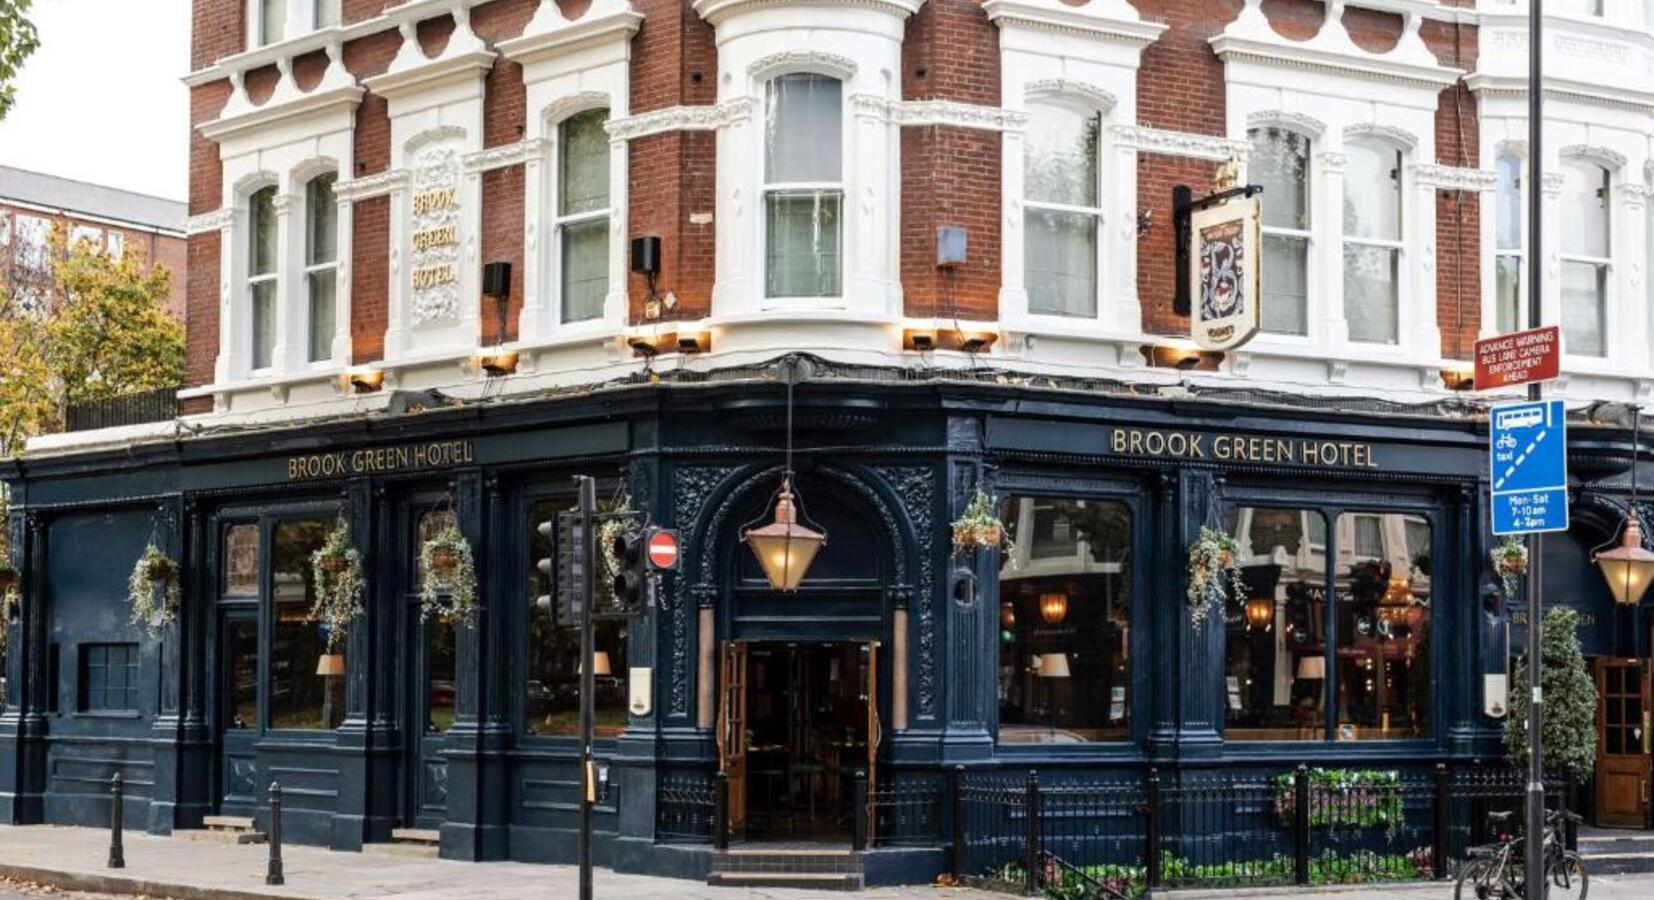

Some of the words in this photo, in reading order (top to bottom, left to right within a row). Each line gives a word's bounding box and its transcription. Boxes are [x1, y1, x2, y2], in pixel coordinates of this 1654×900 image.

[412, 187, 458, 216] BROOK
[412, 226, 457, 250] GREEN
[412, 266, 456, 290] HOTEL
[1480, 338, 1514, 354] ADVANCE
[1516, 331, 1554, 347] WARNING
[1482, 353, 1497, 365] BUS
[1499, 349, 1517, 362] LANE
[1519, 344, 1551, 358] CAMERA
[1488, 356, 1542, 374] ENFORCEMENT
[1503, 370, 1528, 382] AHEAD
[288, 453, 346, 478] BROOK
[352, 448, 408, 472] GREEN
[414, 441, 473, 467] HOTEL
[1111, 429, 1204, 457] BROOK
[1213, 436, 1293, 462] GREEN
[1302, 441, 1378, 467] HOTEL
[1496, 451, 1513, 461] taxi
